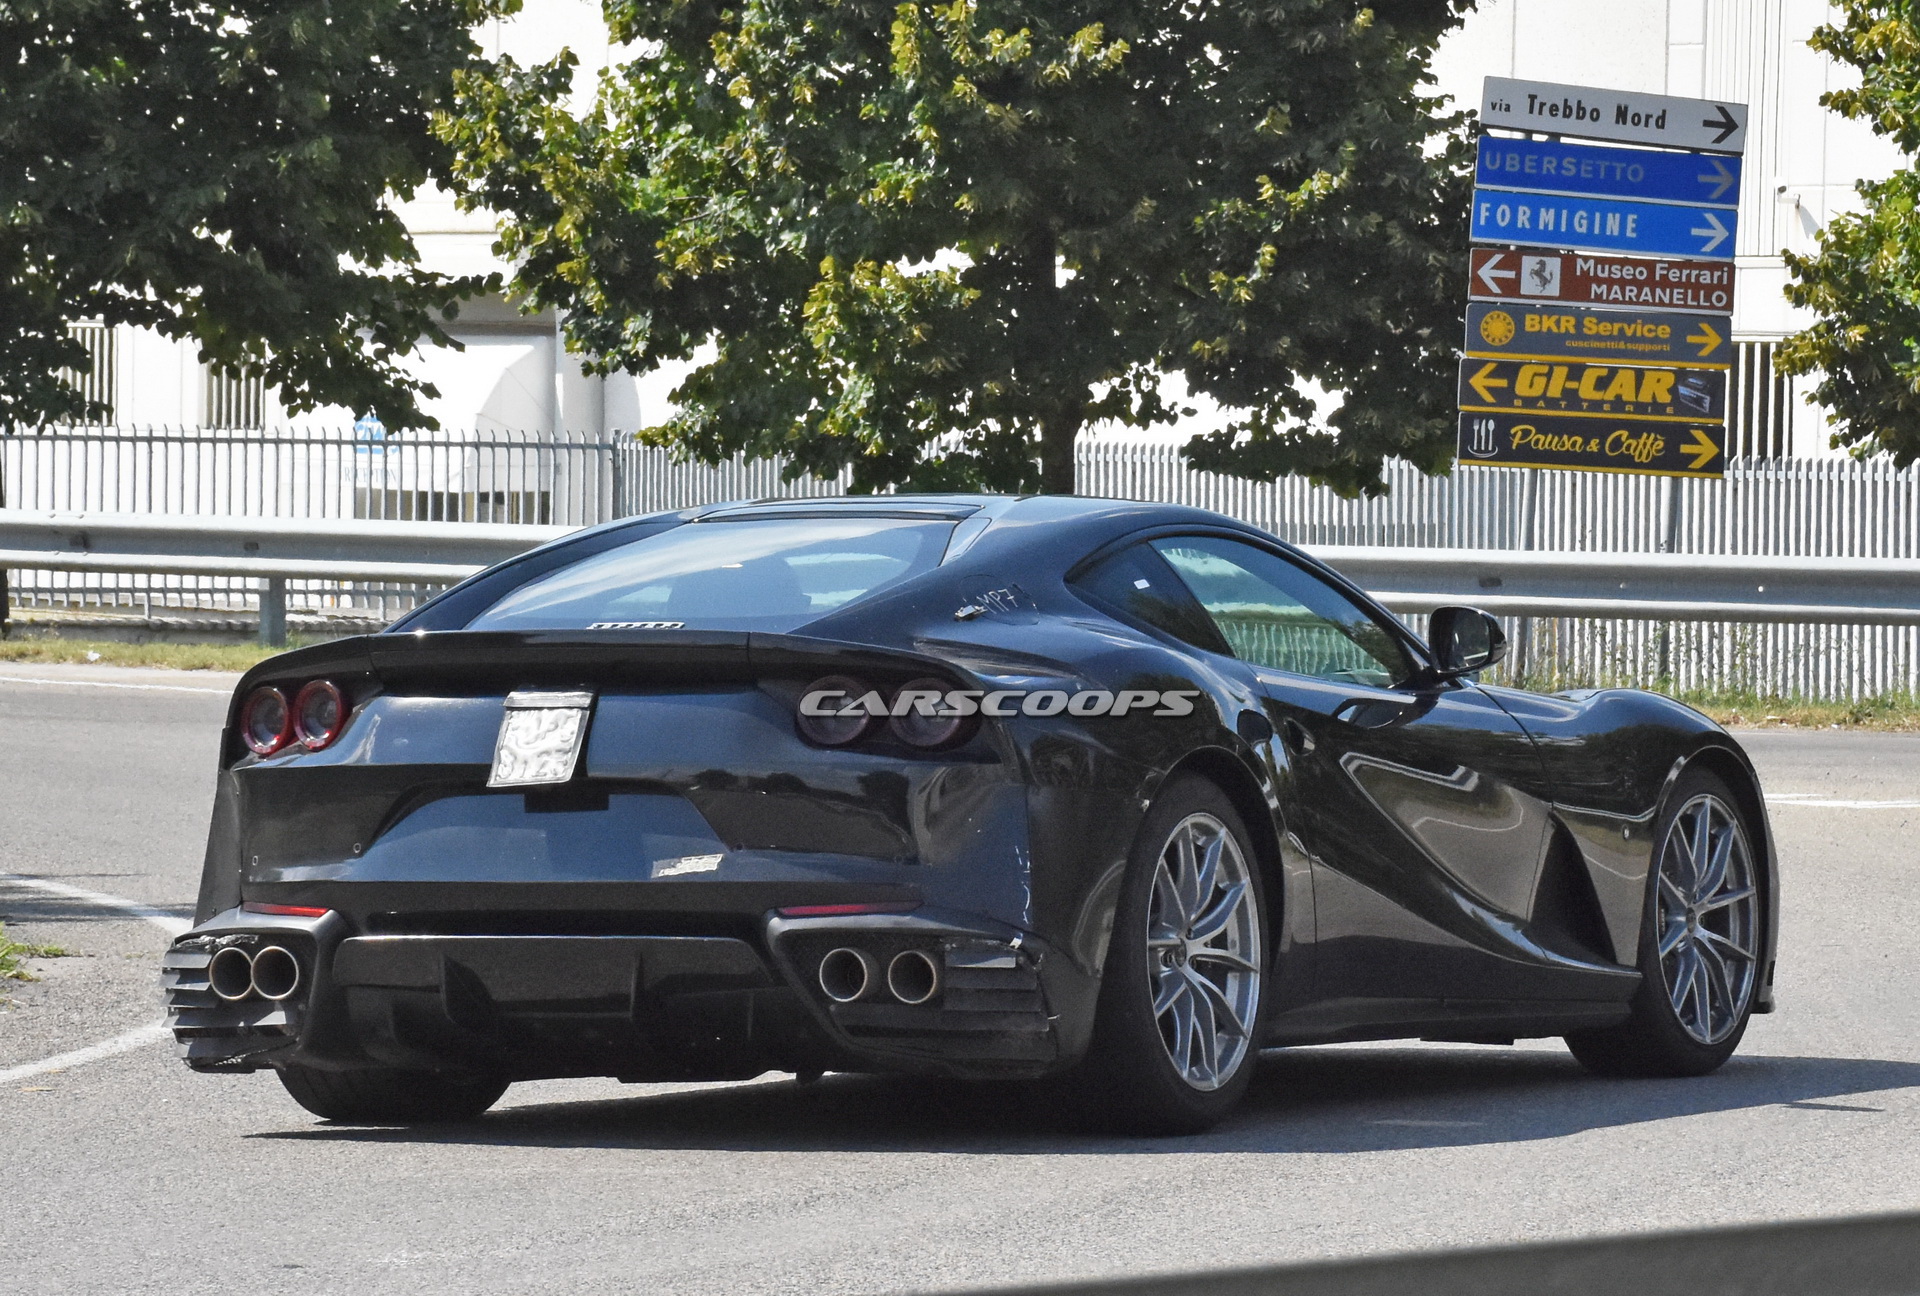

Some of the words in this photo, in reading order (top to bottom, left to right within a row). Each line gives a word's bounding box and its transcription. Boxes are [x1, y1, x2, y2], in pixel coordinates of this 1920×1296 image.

[1491, 98, 1511, 113] via
[1527, 94, 1600, 122] Trebbo
[1615, 104, 1667, 130] Nord
[1484, 151, 1645, 183] UBERSETTO
[1479, 202, 1638, 238] FORMIGINE
[1576, 258, 1647, 280] Museo
[1655, 263, 1728, 285] Ferrari
[1591, 284, 1727, 307] MARANELLO
[1524, 313, 1576, 335] BKR
[1583, 317, 1671, 339] Service
[1514, 363, 1676, 404] GI-CAR
[1514, 399, 1675, 414] BATTERIE
[1509, 424, 1586, 453] Pausa
[1586, 438, 1600, 453] &
[1605, 429, 1665, 463] Caffè
